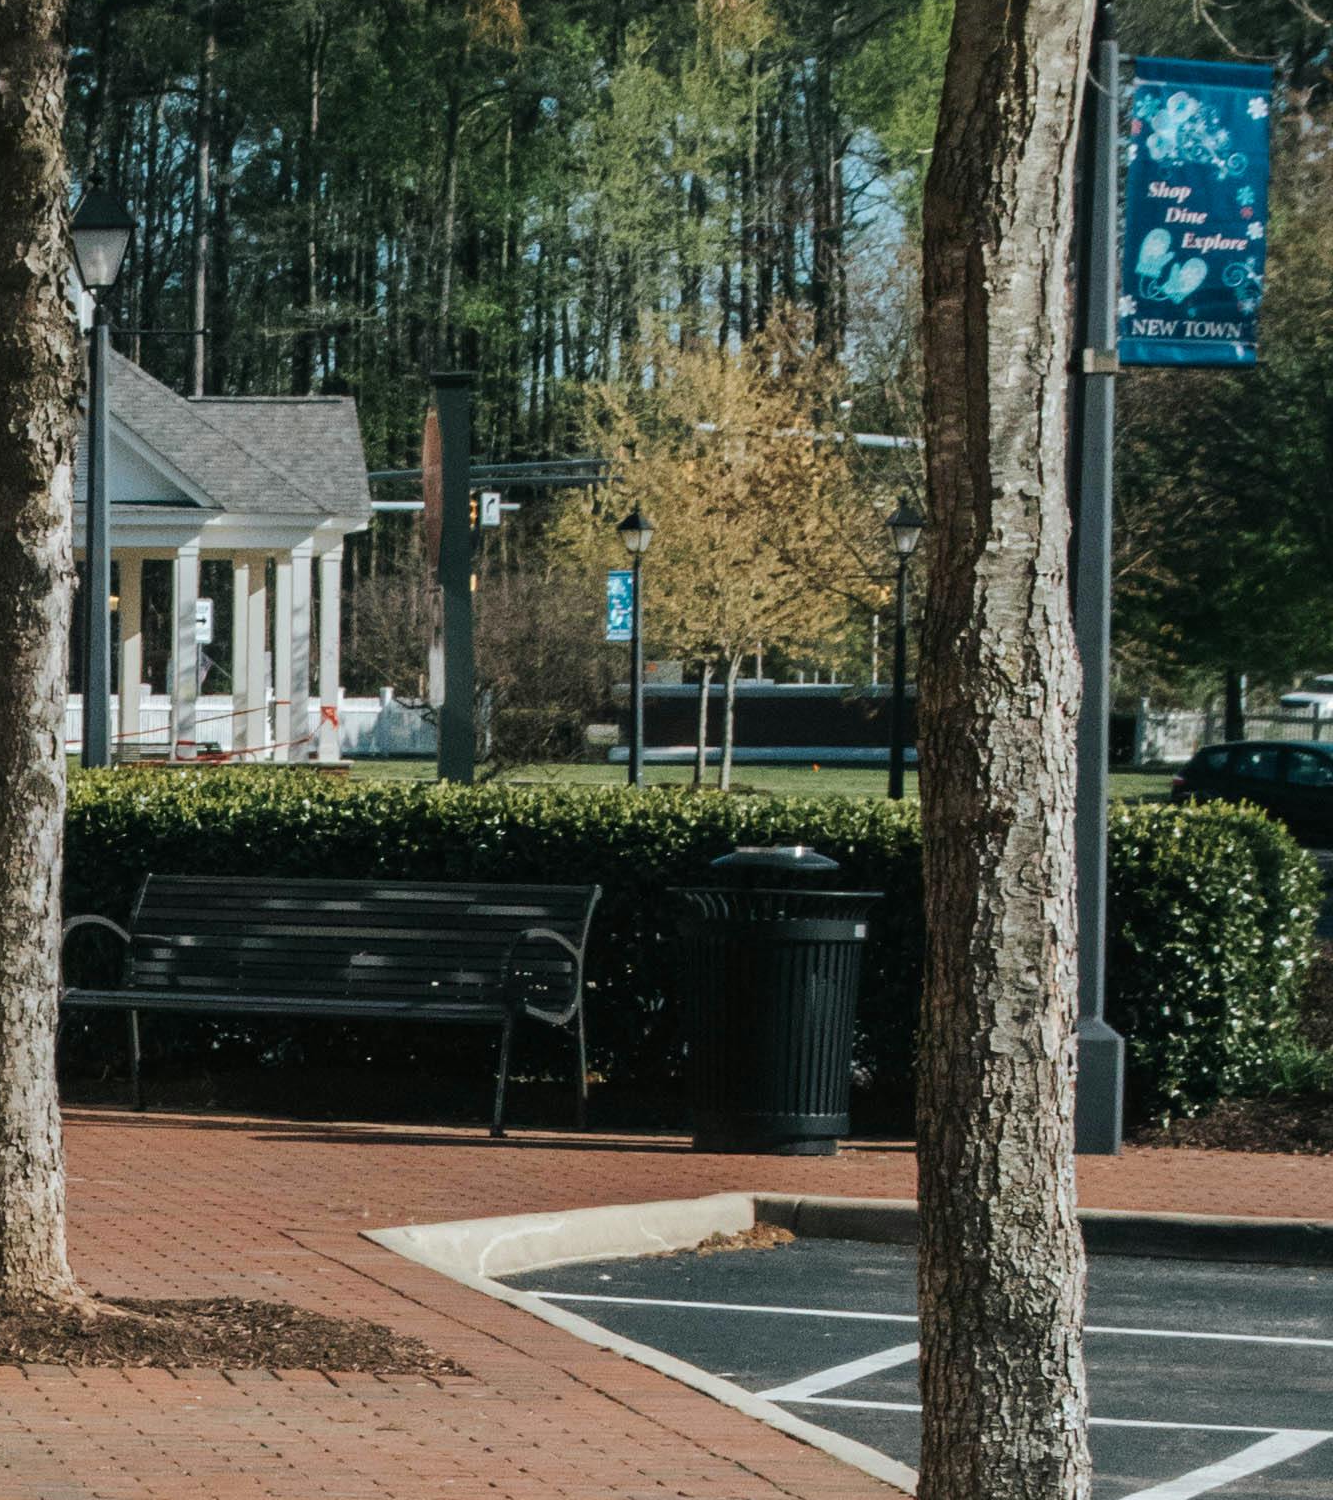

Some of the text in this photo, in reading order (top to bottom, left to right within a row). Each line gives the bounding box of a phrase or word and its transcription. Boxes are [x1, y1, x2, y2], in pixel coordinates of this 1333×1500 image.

[1148, 181, 1192, 203] Shop
[1165, 206, 1208, 224] Dine
[1181, 232, 1248, 254] Explore
[1132, 318, 1243, 339] NEW TOWN
